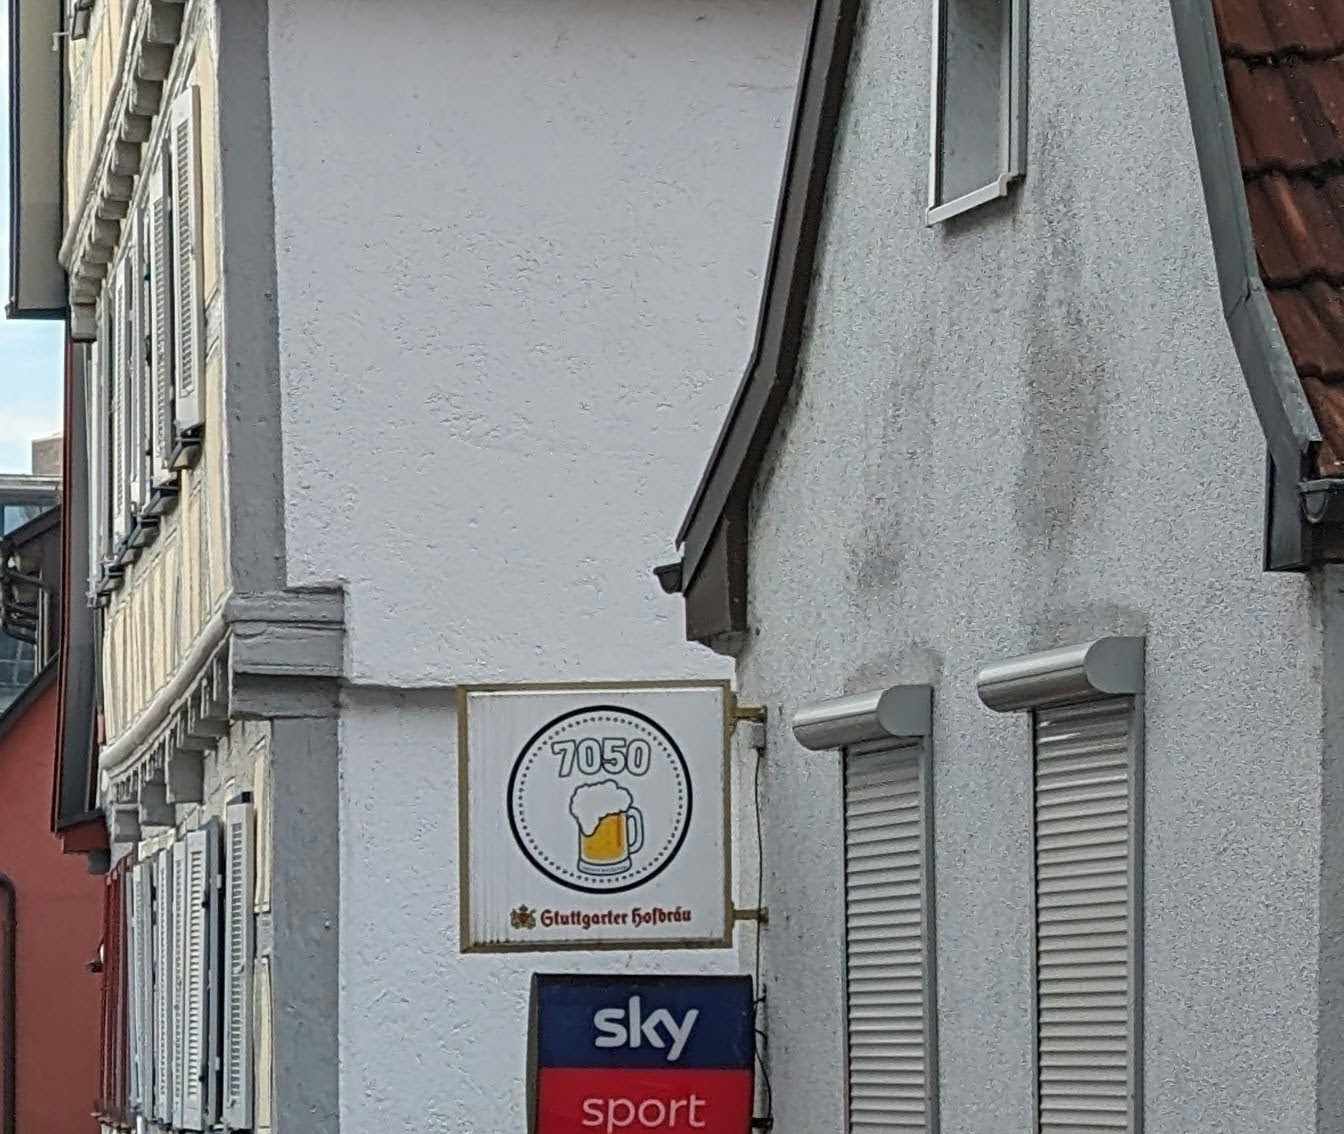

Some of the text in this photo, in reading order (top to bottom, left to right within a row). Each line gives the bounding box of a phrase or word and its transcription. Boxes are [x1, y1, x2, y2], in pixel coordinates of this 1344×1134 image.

[550, 737, 651, 778] 7050
[540, 906, 692, 930] Stuttgarter Hofbräu
[593, 995, 700, 1062] sky
[582, 1093, 706, 1134] sport
